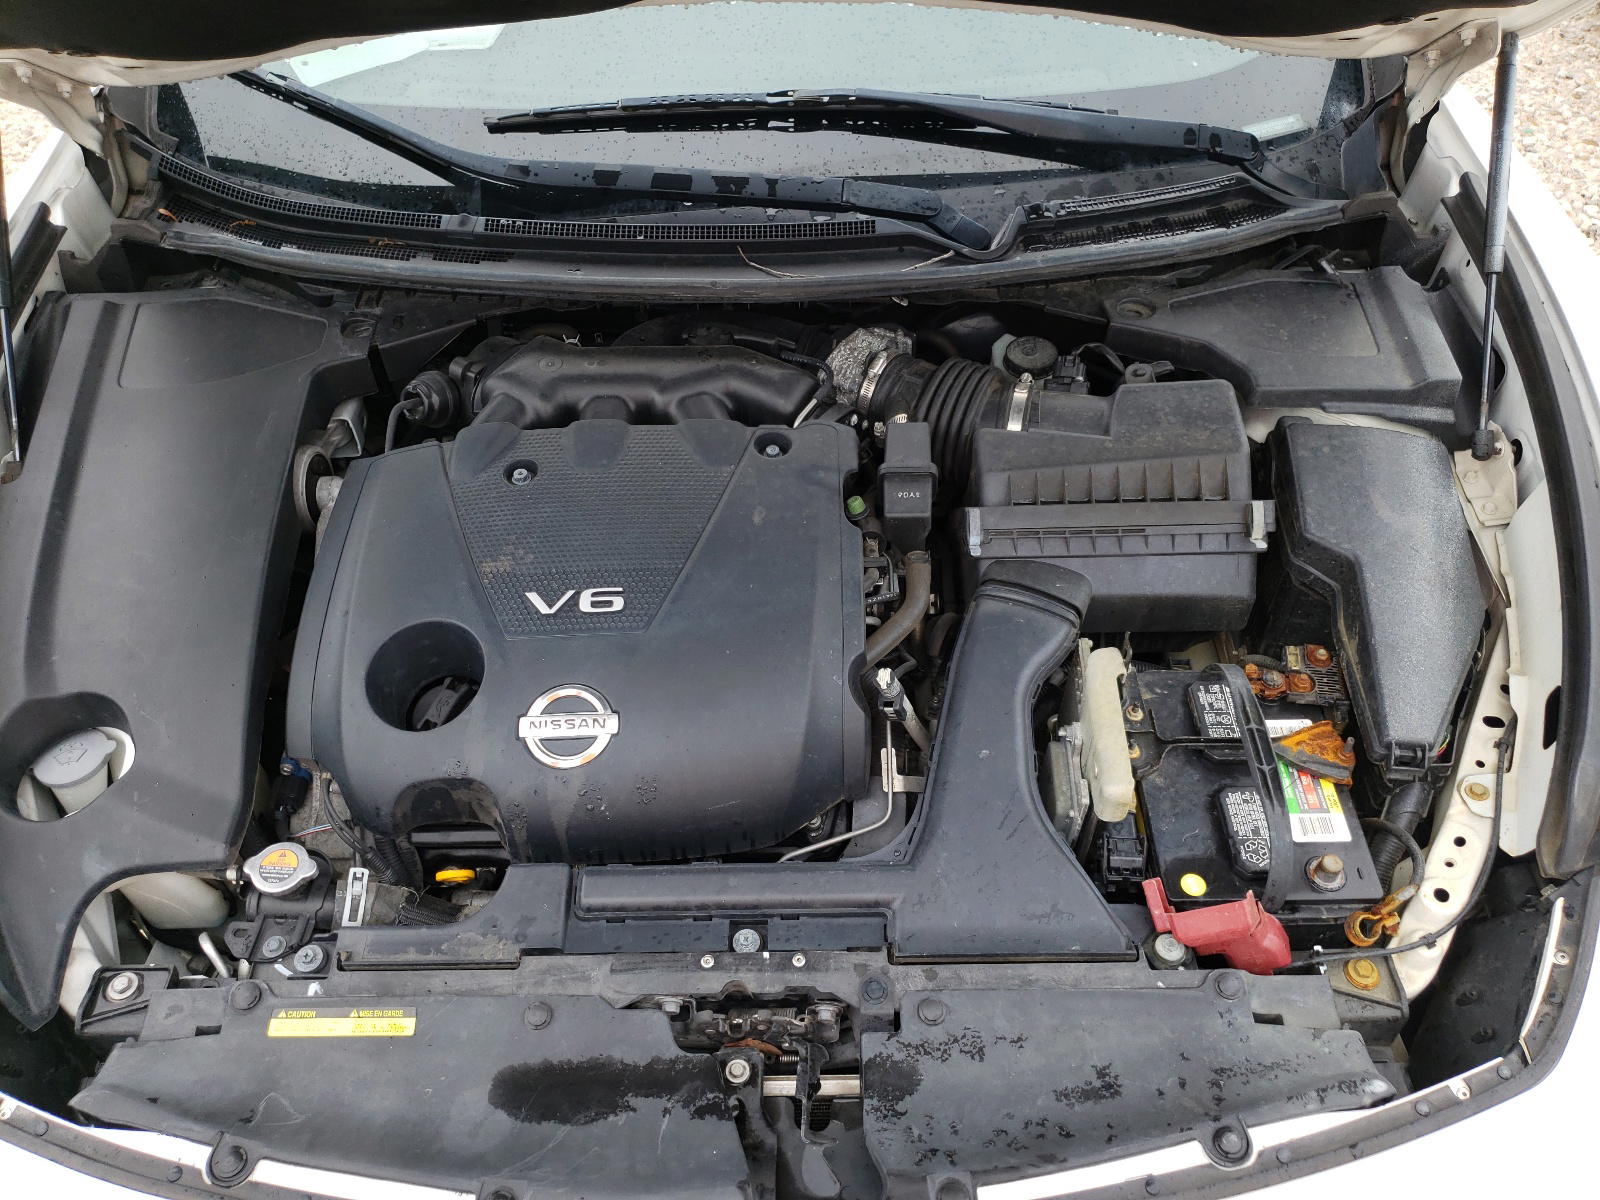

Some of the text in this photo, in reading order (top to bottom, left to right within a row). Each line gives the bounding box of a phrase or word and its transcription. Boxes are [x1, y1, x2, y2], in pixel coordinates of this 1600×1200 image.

[525, 587, 625, 615] V6
[529, 717, 607, 730] NISSAN
[287, 1010, 316, 1018] CAUTION
